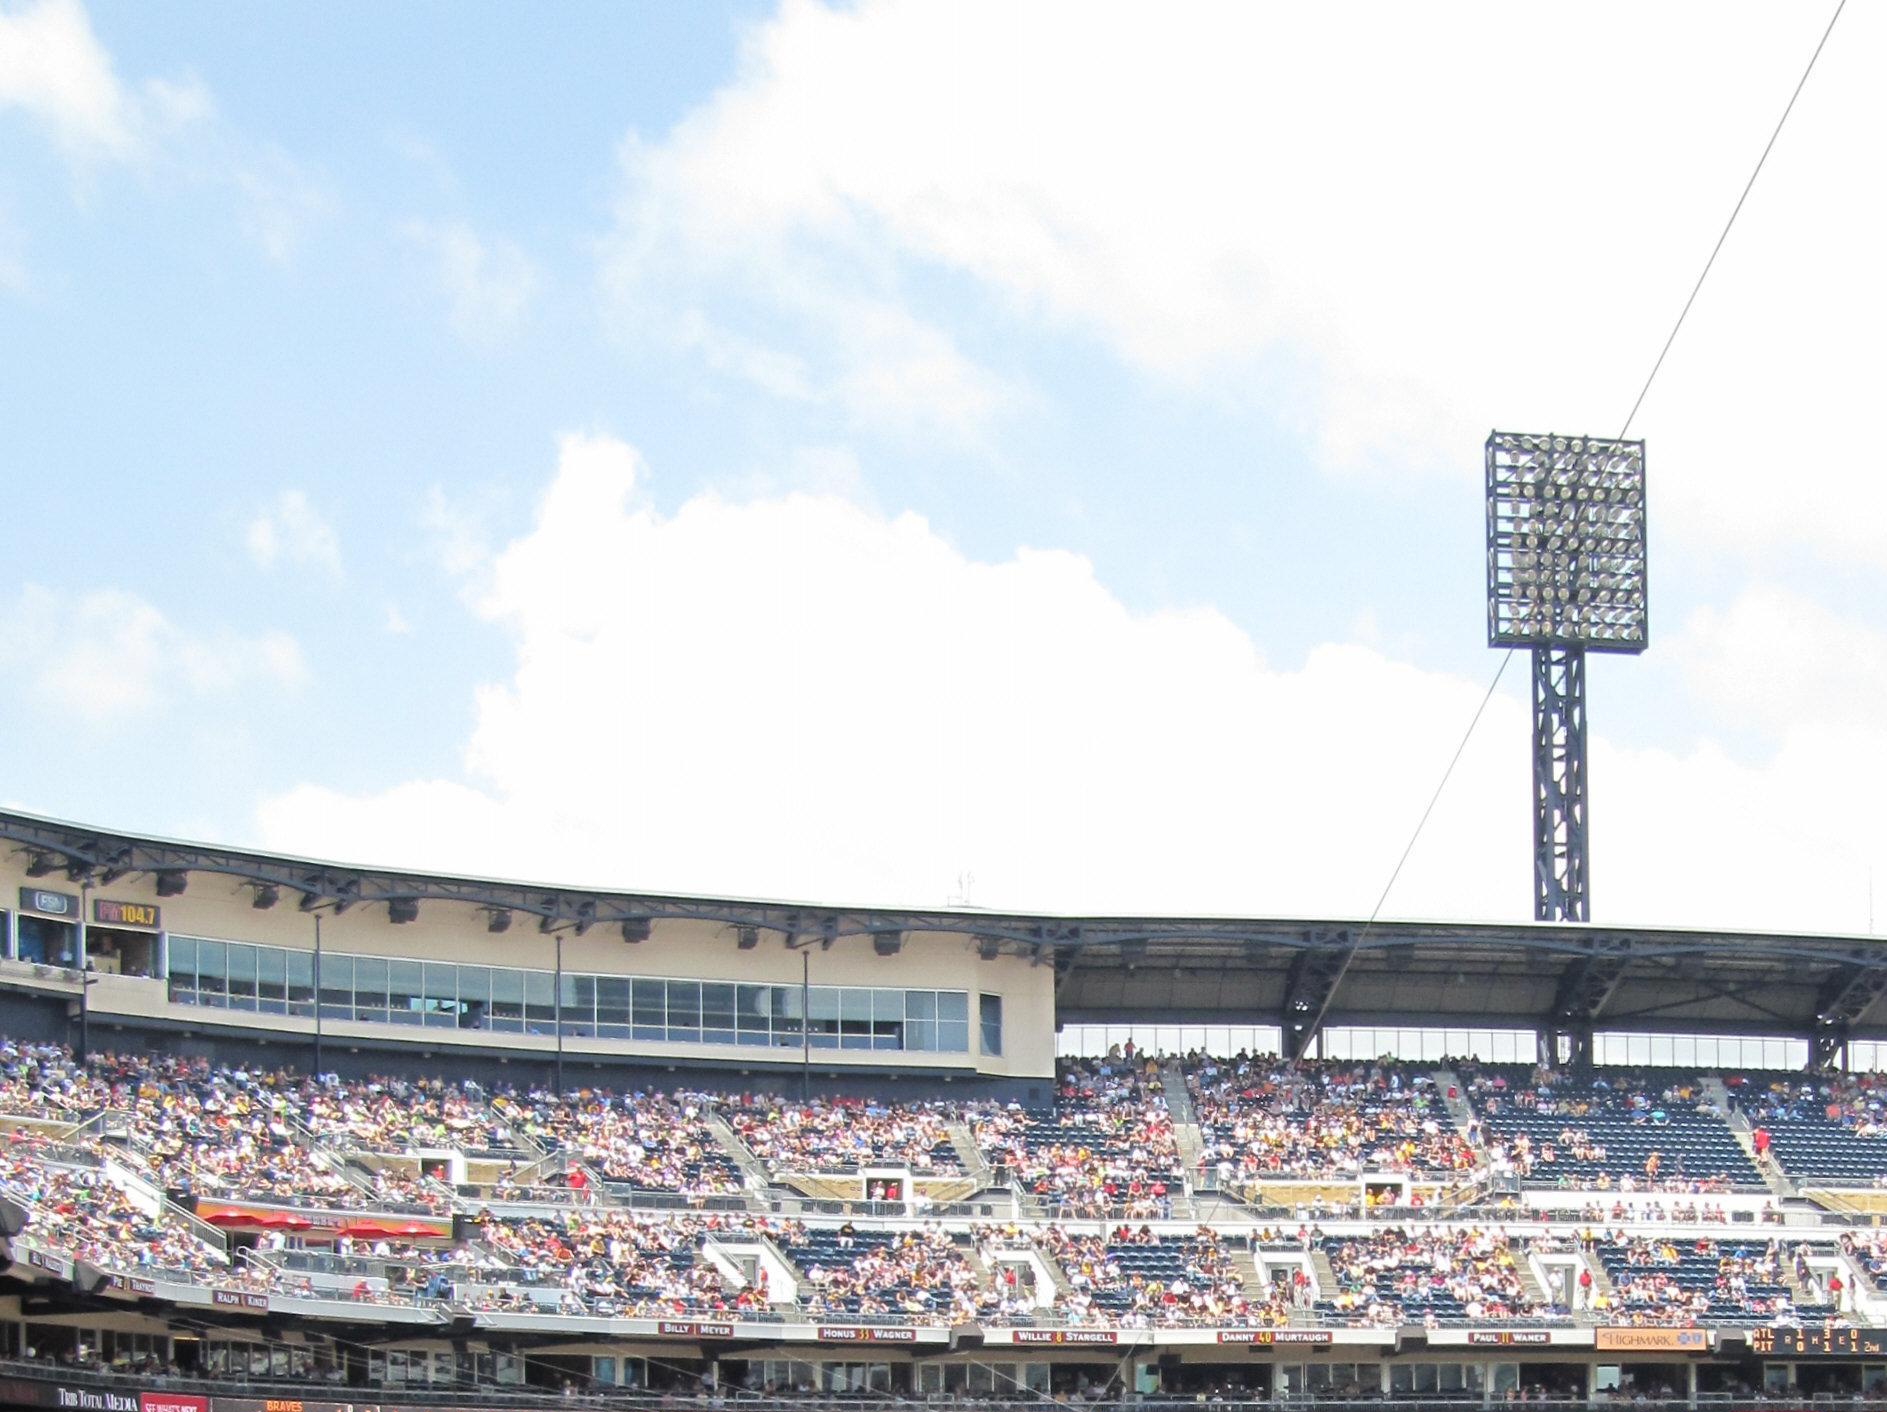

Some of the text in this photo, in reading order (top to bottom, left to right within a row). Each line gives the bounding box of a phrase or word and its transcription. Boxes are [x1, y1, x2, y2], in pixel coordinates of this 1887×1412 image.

[122, 904, 155, 925] 104.7
[664, 1323, 730, 1335] BILLY MEYER
[823, 1329, 912, 1339] HONUS WAGNER
[1018, 1332, 1112, 1341] WILLIE STARGELL
[1222, 1332, 1328, 1341] DANNY MURTAUGH
[1473, 1332, 1546, 1343] PAUL WANER
[267, 1401, 304, 1411] BRAVES
